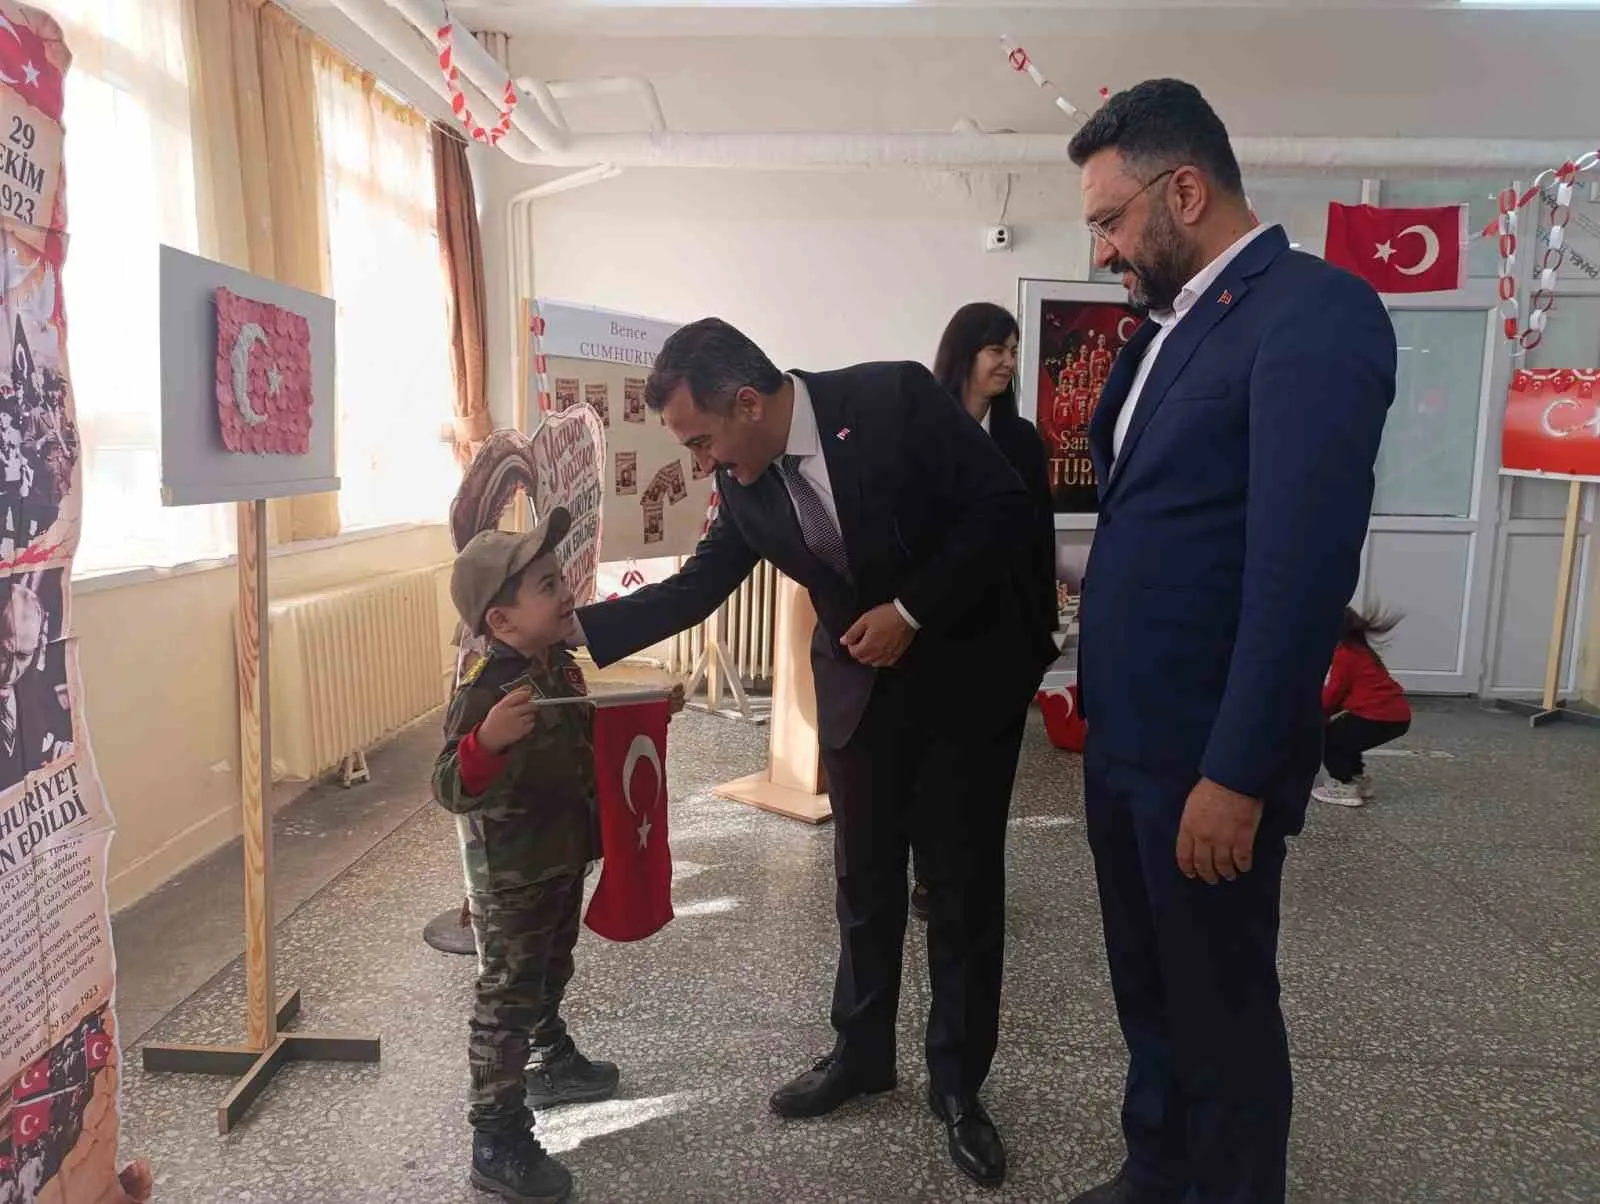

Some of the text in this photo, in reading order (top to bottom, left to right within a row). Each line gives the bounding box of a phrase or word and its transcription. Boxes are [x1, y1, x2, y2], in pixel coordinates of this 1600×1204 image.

[9, 115, 35, 150] 29
[0, 183, 35, 225] 923
[610, 321, 647, 341] Bence
[1049, 453, 1098, 485] TÜR
[0, 762, 79, 841] HURİYET
[17, 789, 88, 857] EDİLDİ
